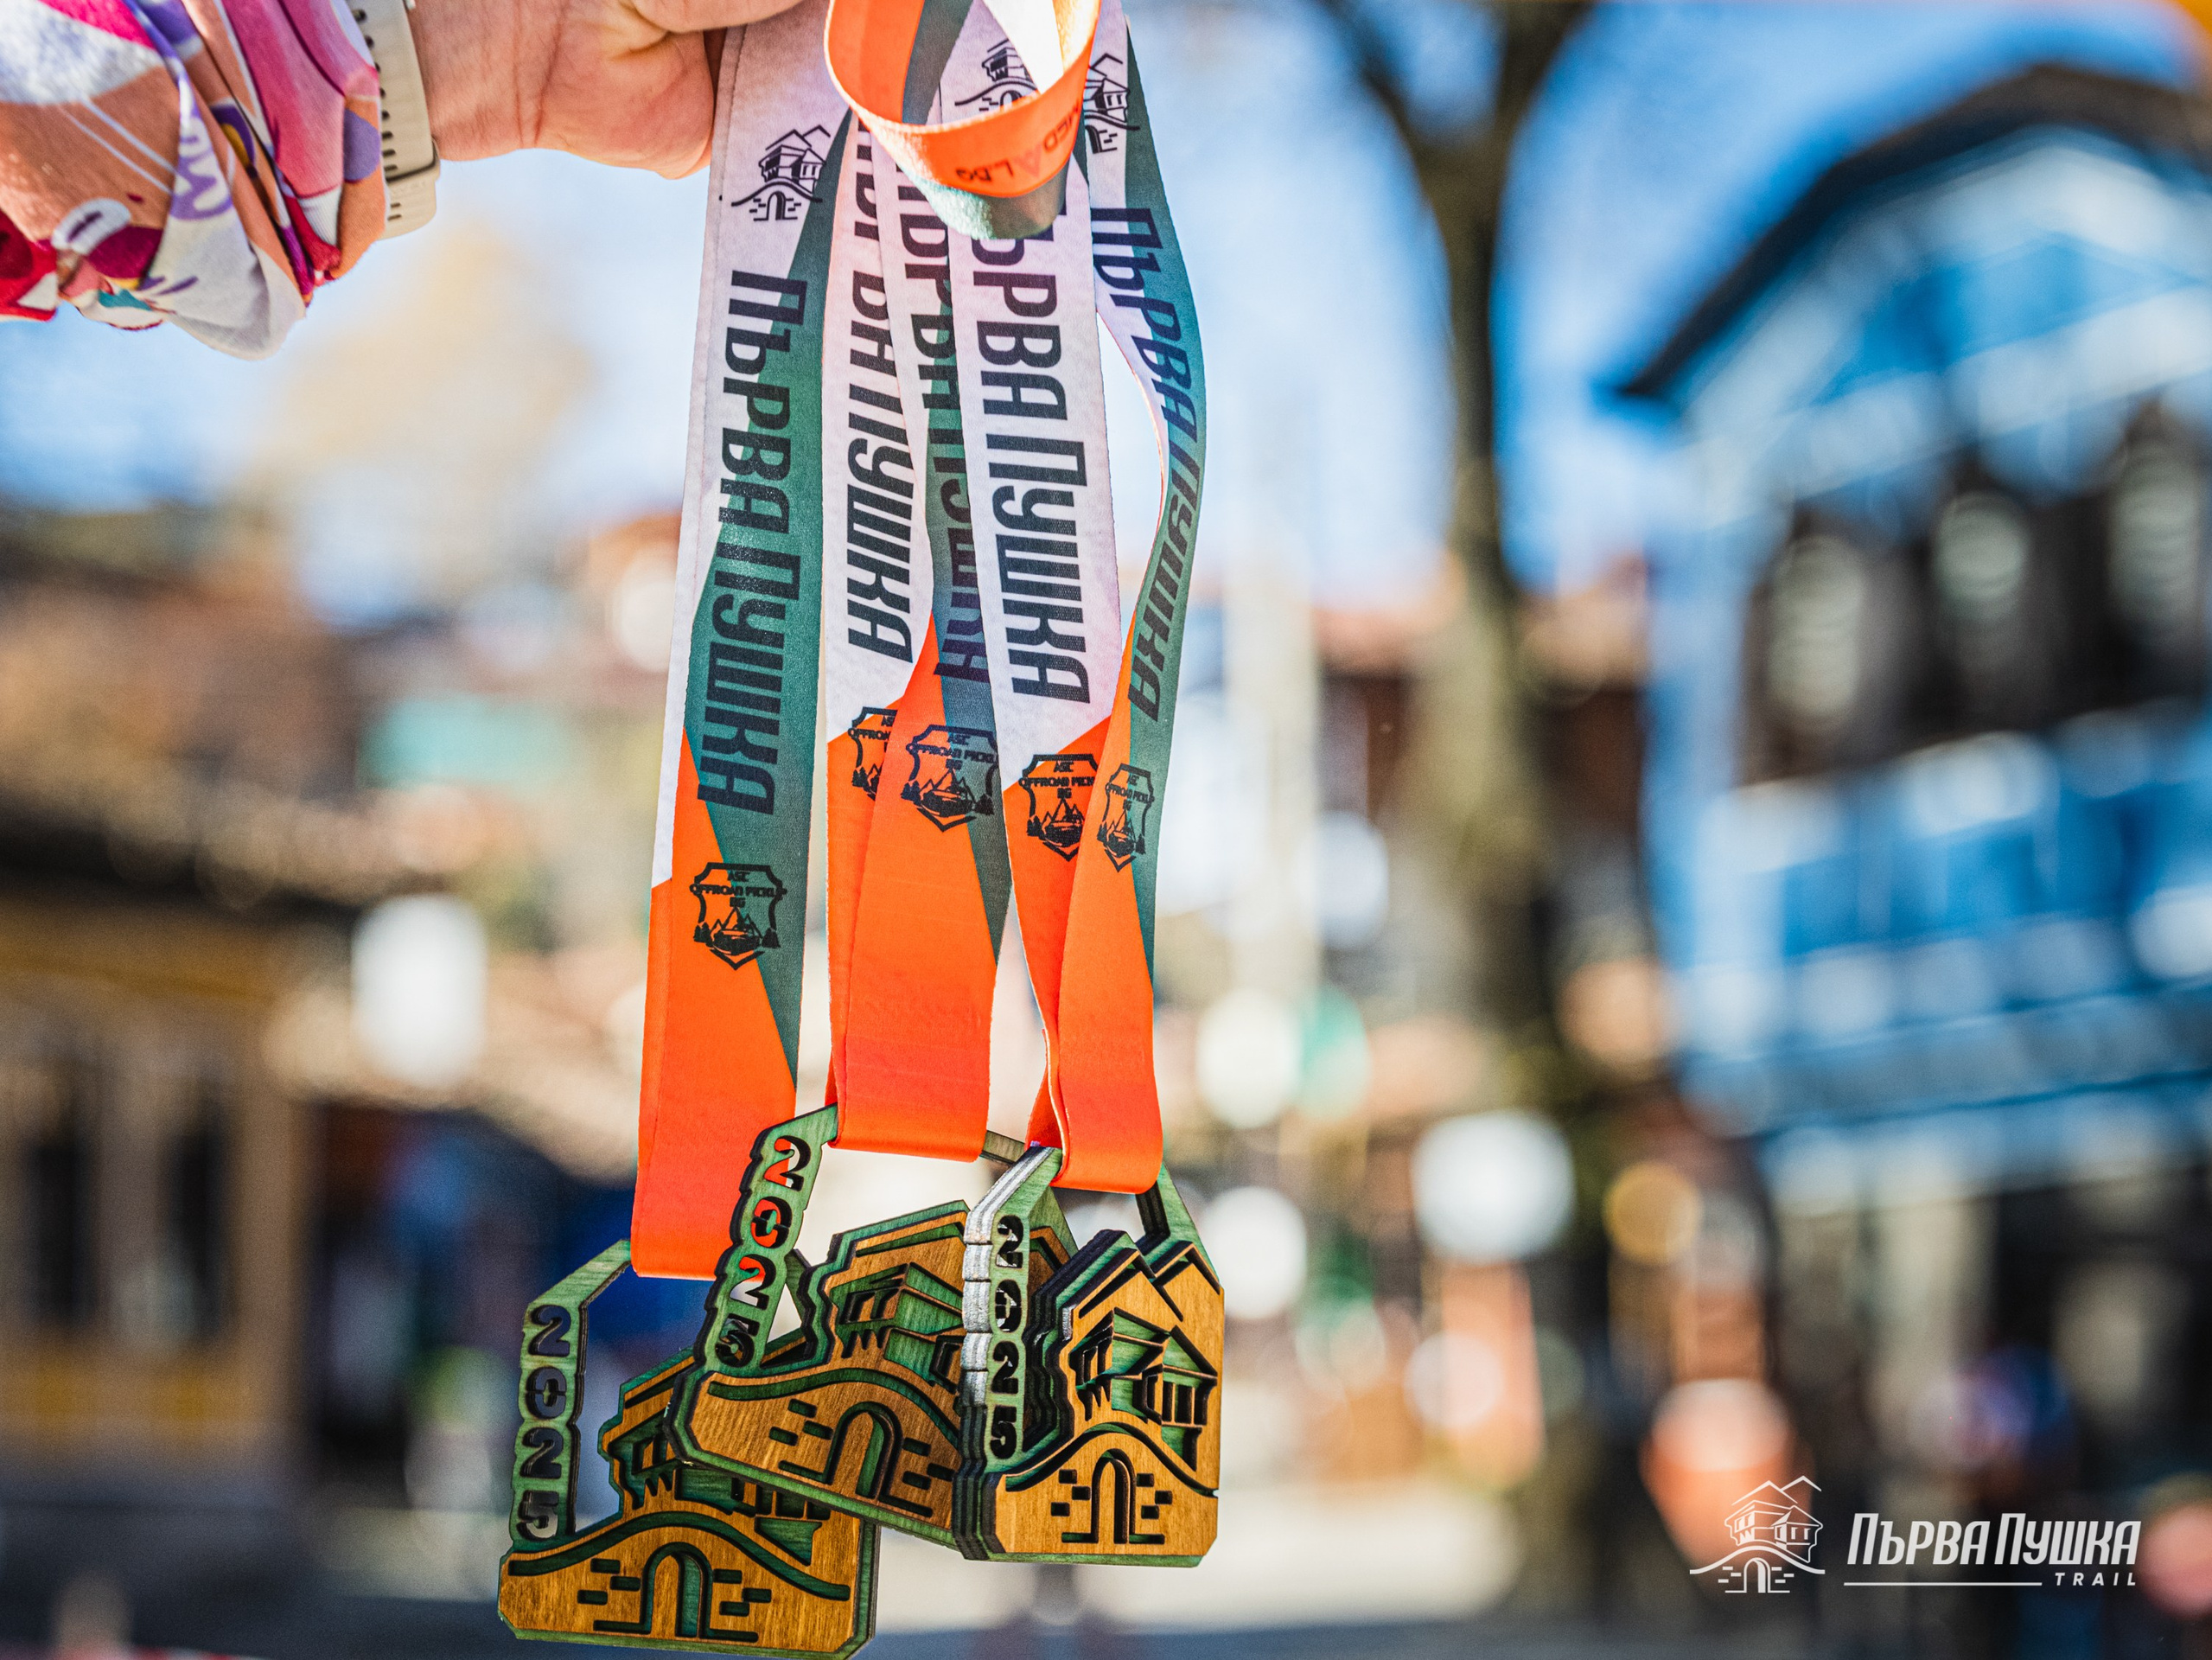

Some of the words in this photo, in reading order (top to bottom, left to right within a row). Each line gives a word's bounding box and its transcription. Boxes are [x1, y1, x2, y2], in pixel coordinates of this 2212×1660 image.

[718, 270, 807, 533] ПЪРВА
[971, 177, 1068, 420] ЪРВА
[1090, 208, 1197, 444] ПЪРВА
[698, 542, 800, 815] ПУШКА
[986, 433, 1090, 704] ПУШКА
[1127, 440, 1200, 722] ПУШКА
[714, 1134, 811, 1368] 2025
[989, 1215, 1024, 1459] 2025
[515, 1304, 571, 1541] 2025
